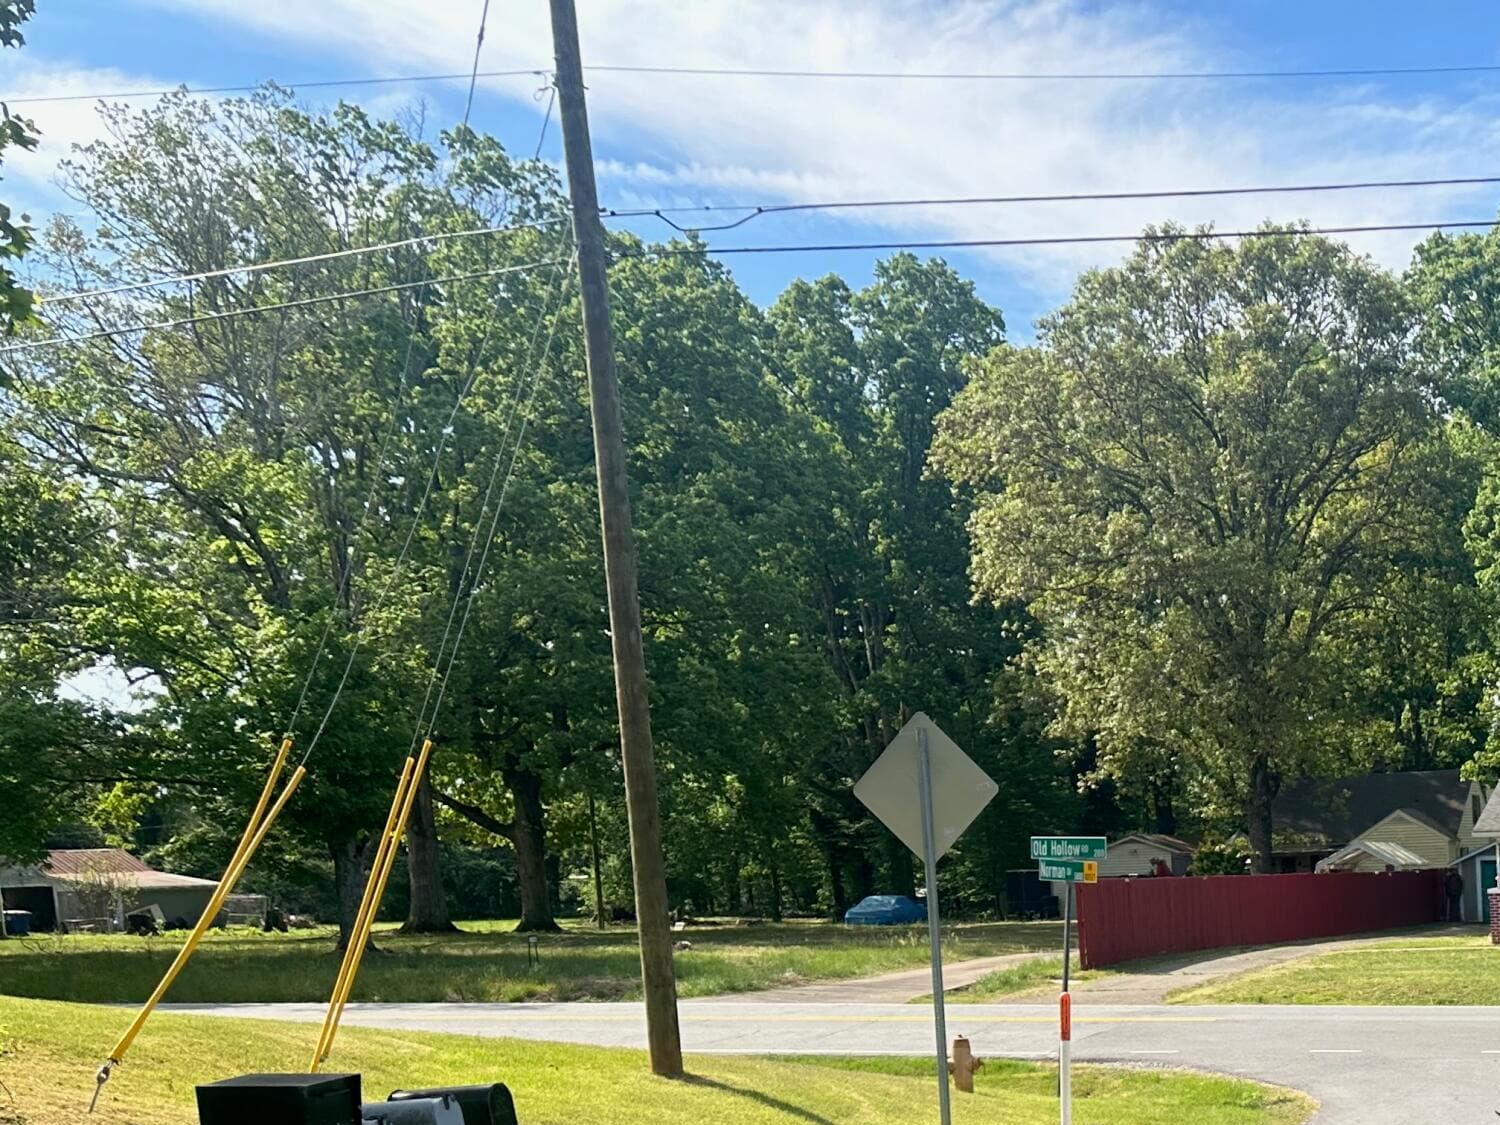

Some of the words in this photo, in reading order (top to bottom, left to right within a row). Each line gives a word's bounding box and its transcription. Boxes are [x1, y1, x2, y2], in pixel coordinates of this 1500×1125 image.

[1033, 840, 1047, 856] Old
[1051, 840, 1081, 856] Hollow
[1040, 861, 1066, 879] Norman
